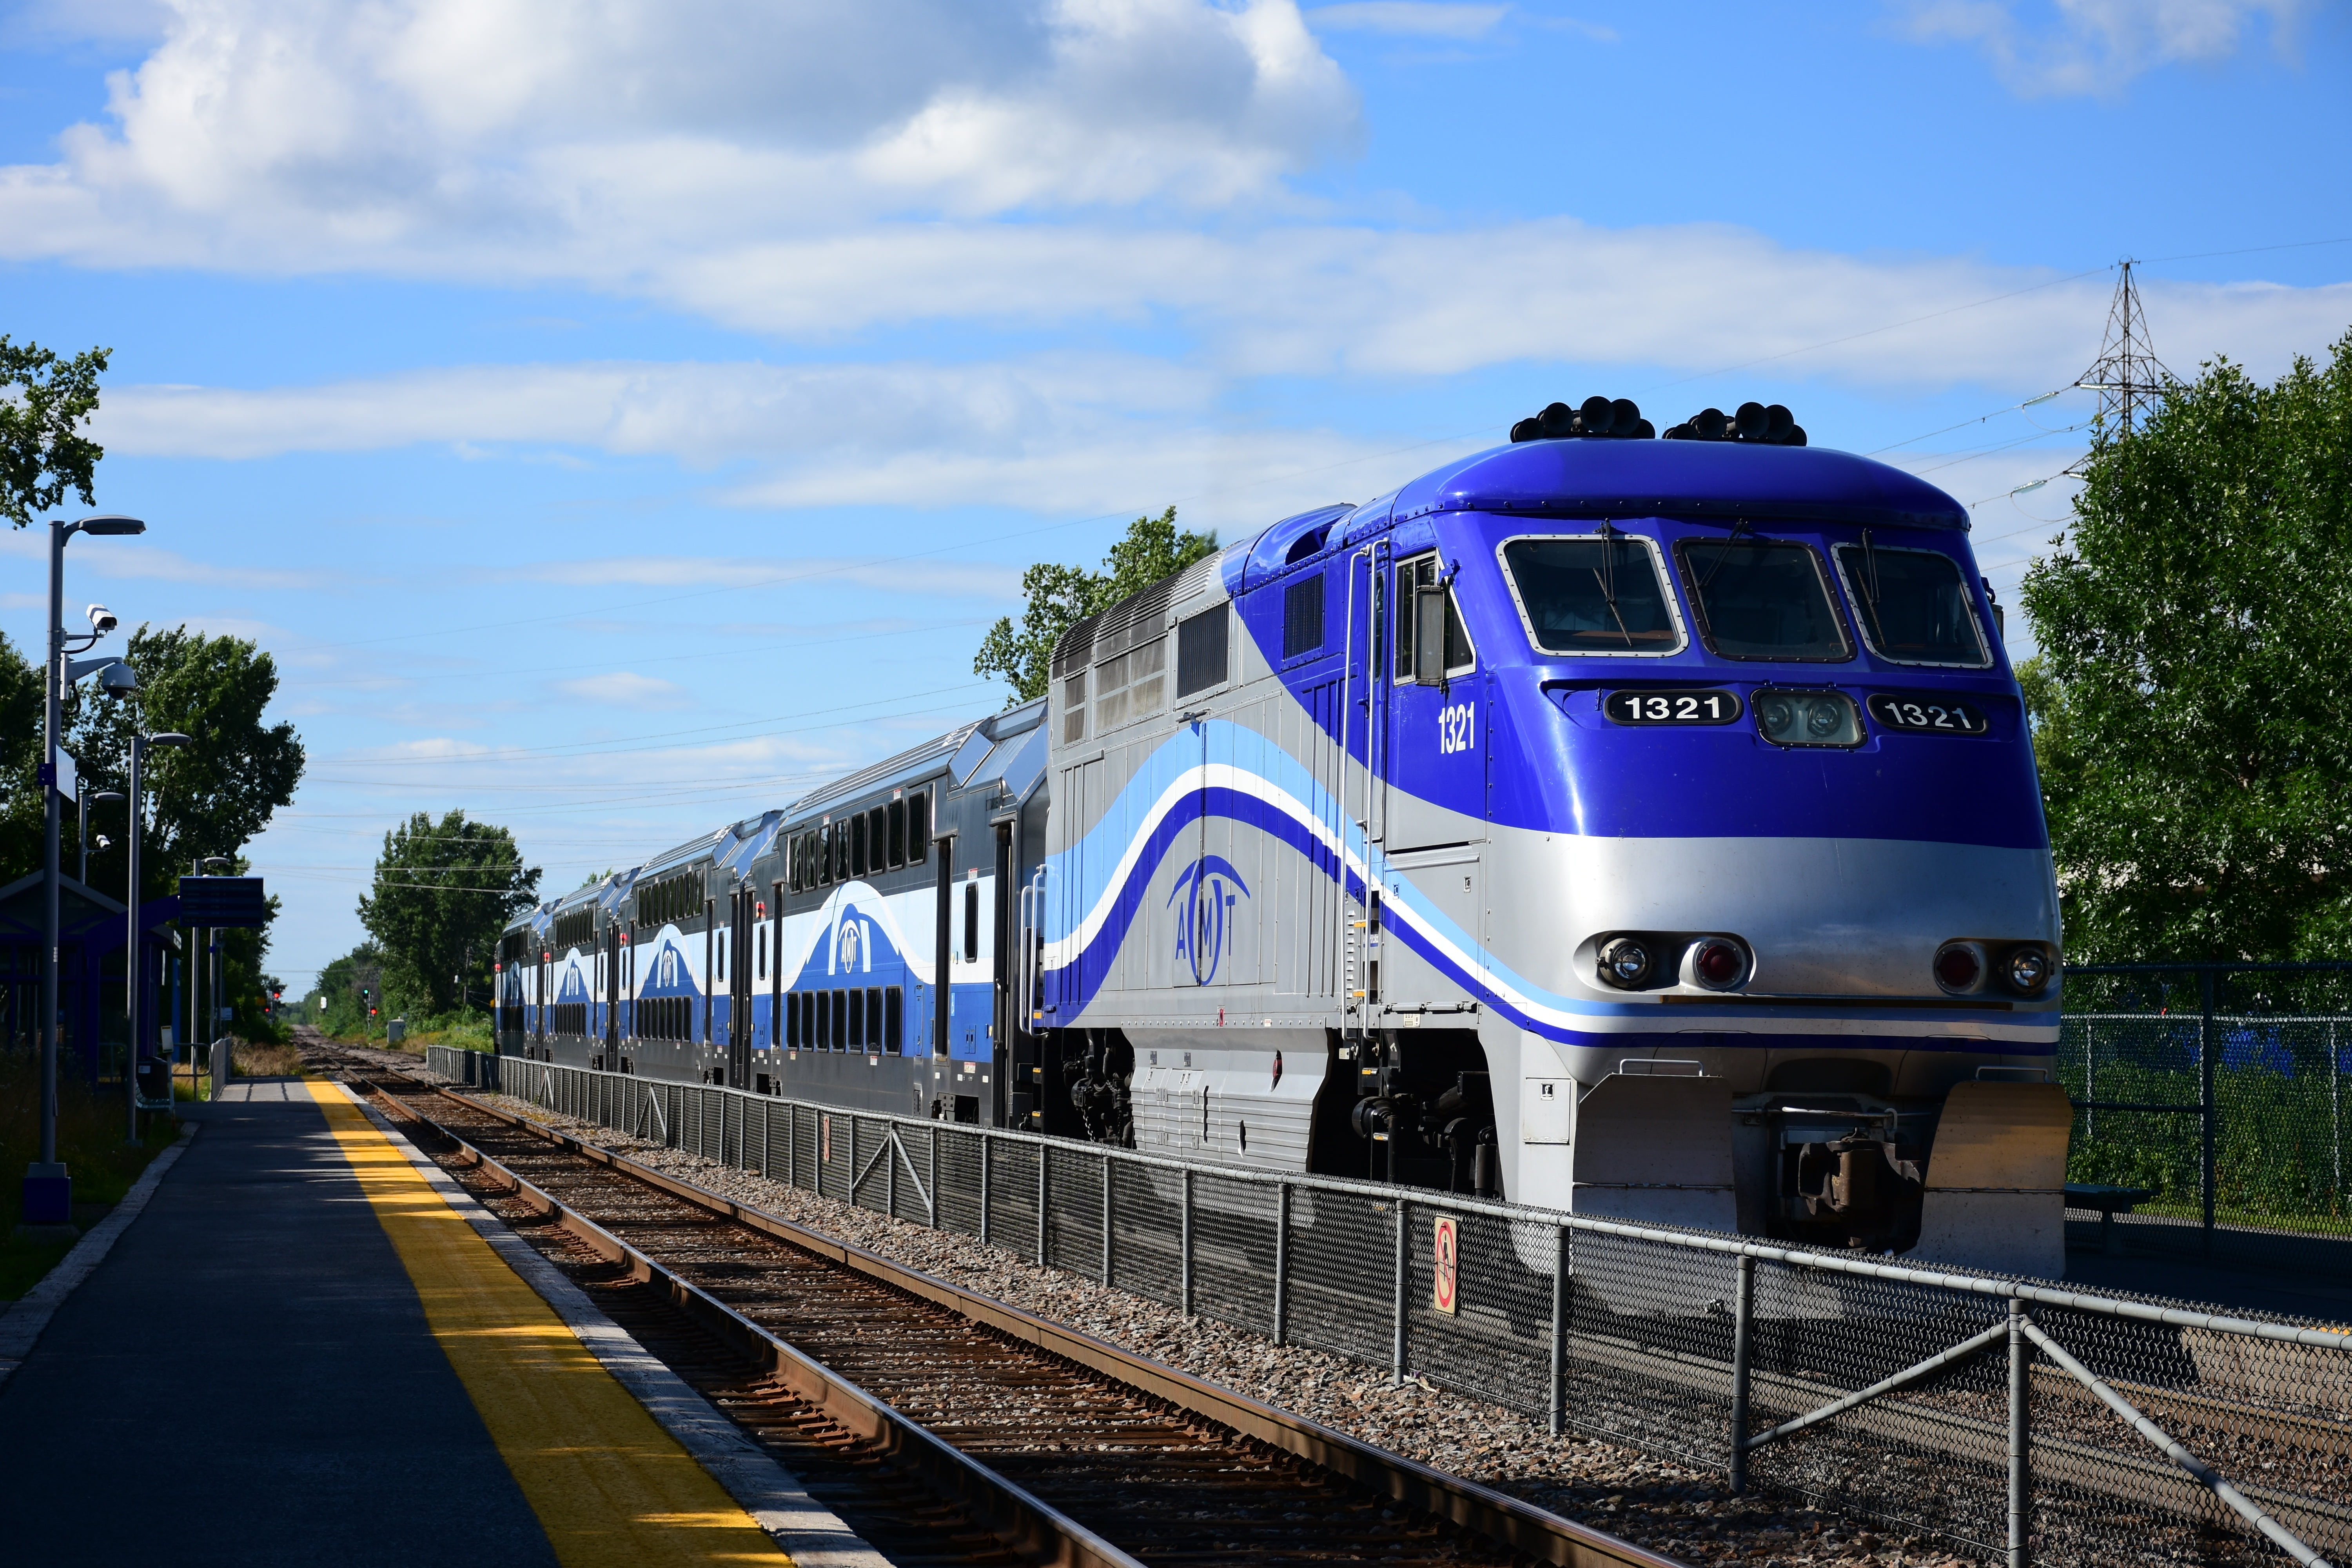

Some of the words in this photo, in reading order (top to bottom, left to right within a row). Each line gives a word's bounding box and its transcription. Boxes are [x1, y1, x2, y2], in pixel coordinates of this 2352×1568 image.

[1625, 697, 1720, 720] 1321
[1884, 702, 1972, 729] 1321
[1438, 701, 1474, 754] 1321
